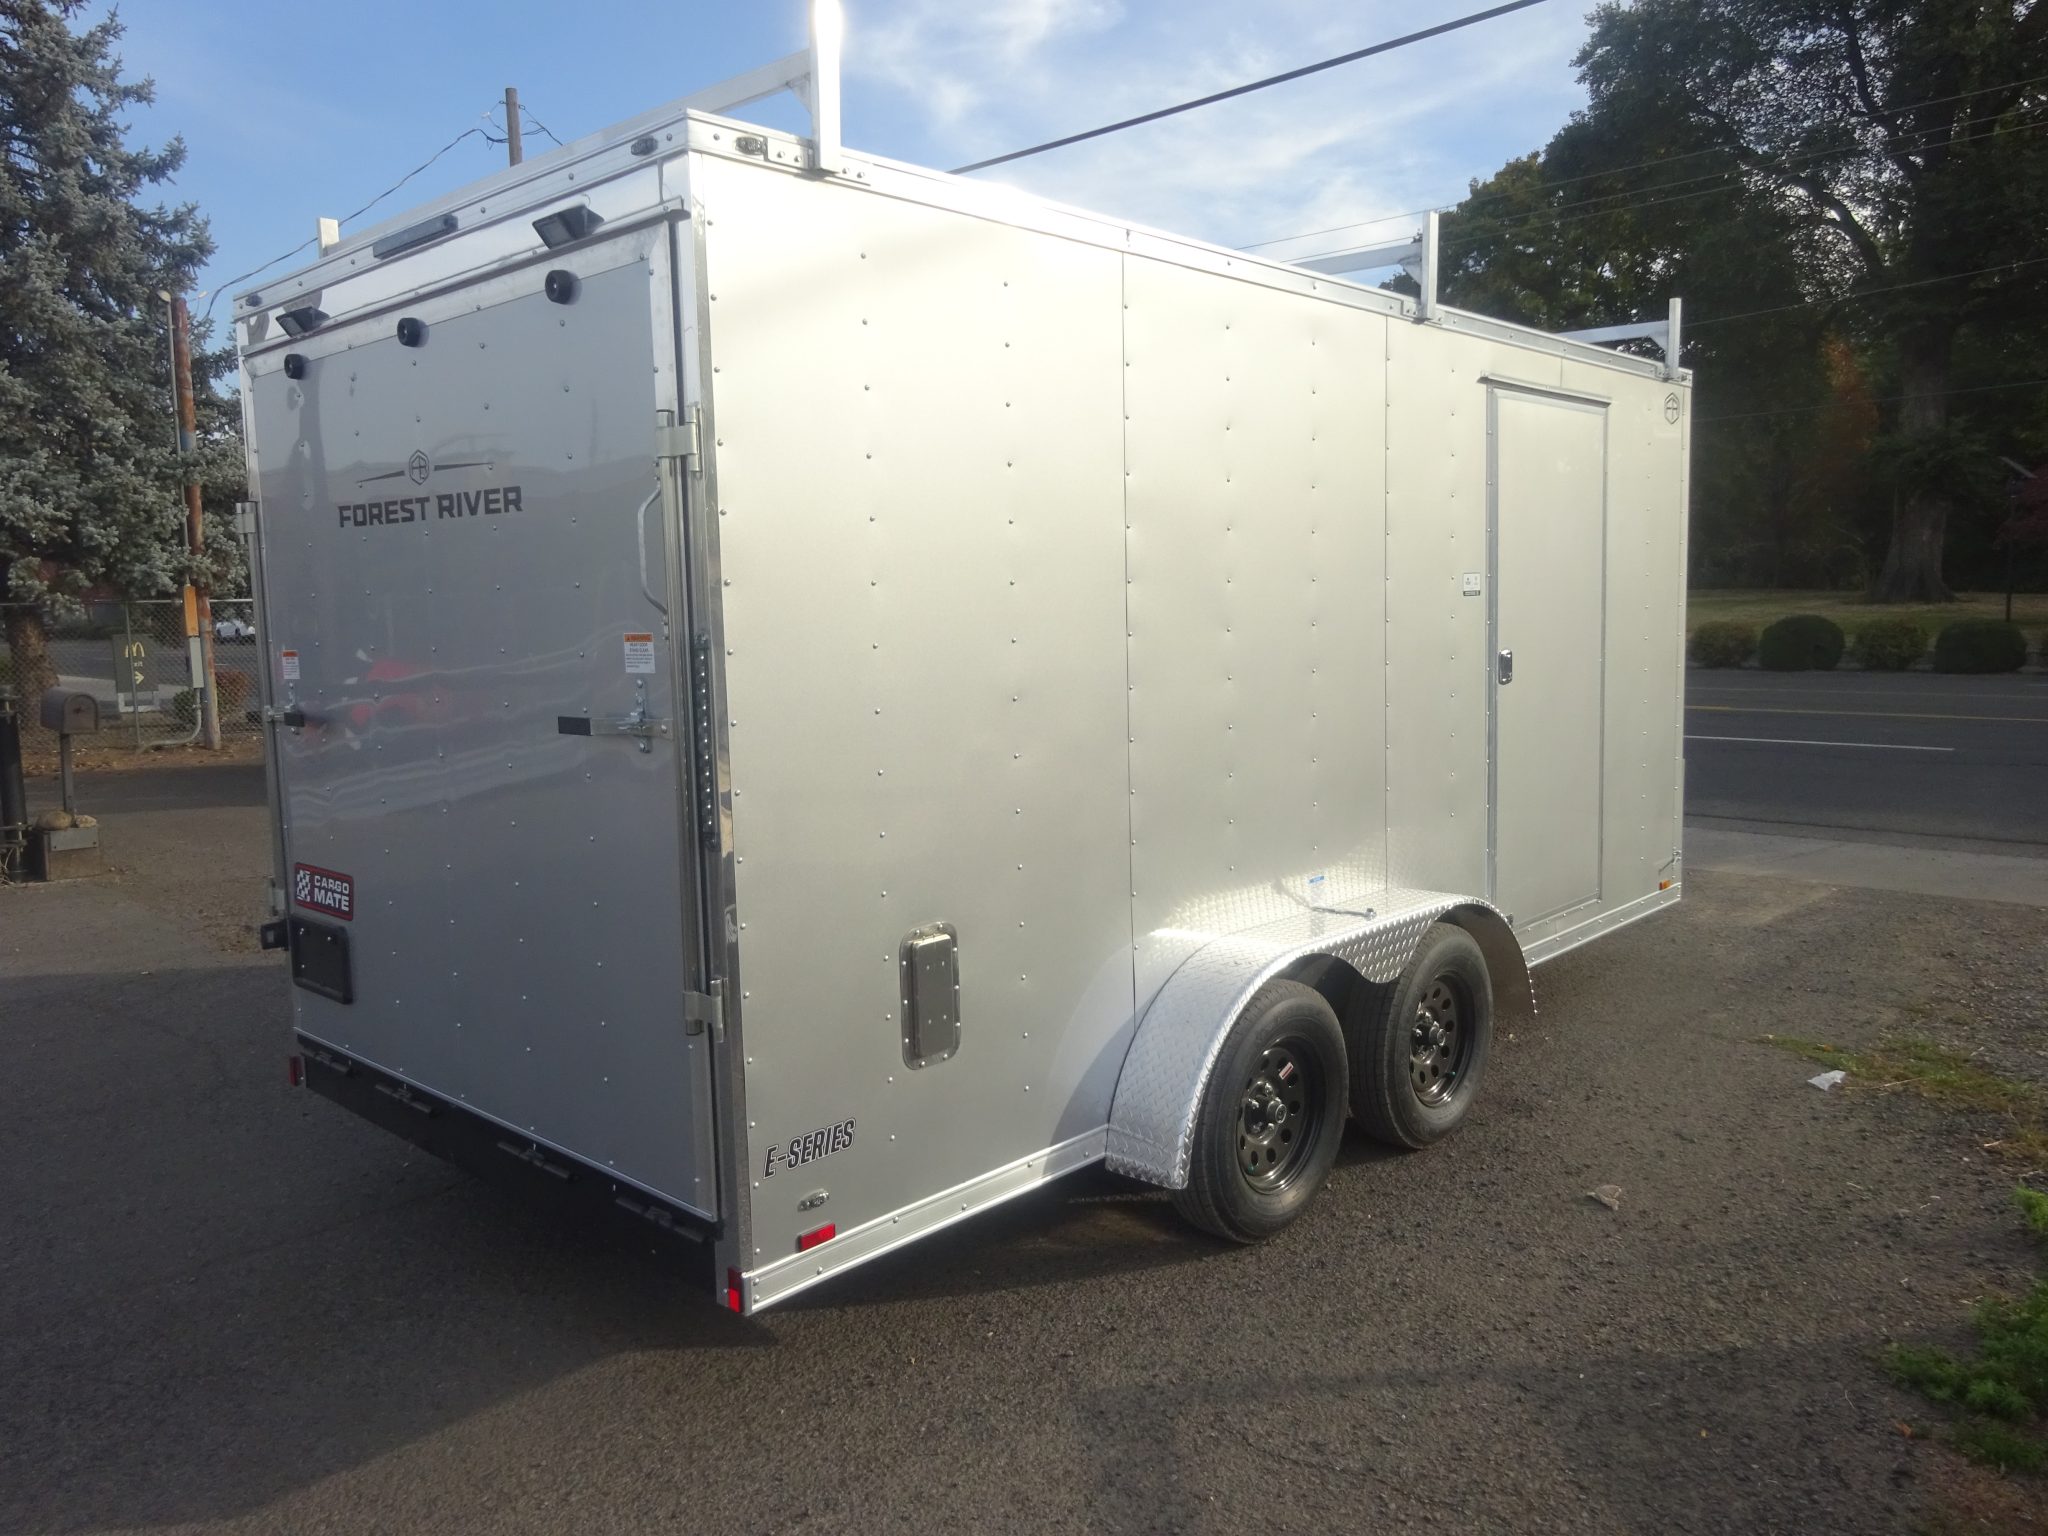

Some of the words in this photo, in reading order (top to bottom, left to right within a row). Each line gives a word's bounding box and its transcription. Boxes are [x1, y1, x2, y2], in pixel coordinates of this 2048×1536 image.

[338, 496, 430, 528] FOREST
[436, 485, 523, 519] RIVER
[314, 875, 350, 894] CARGO
[314, 887, 350, 912] MATE
[763, 1118, 857, 1180] E-SERIES
